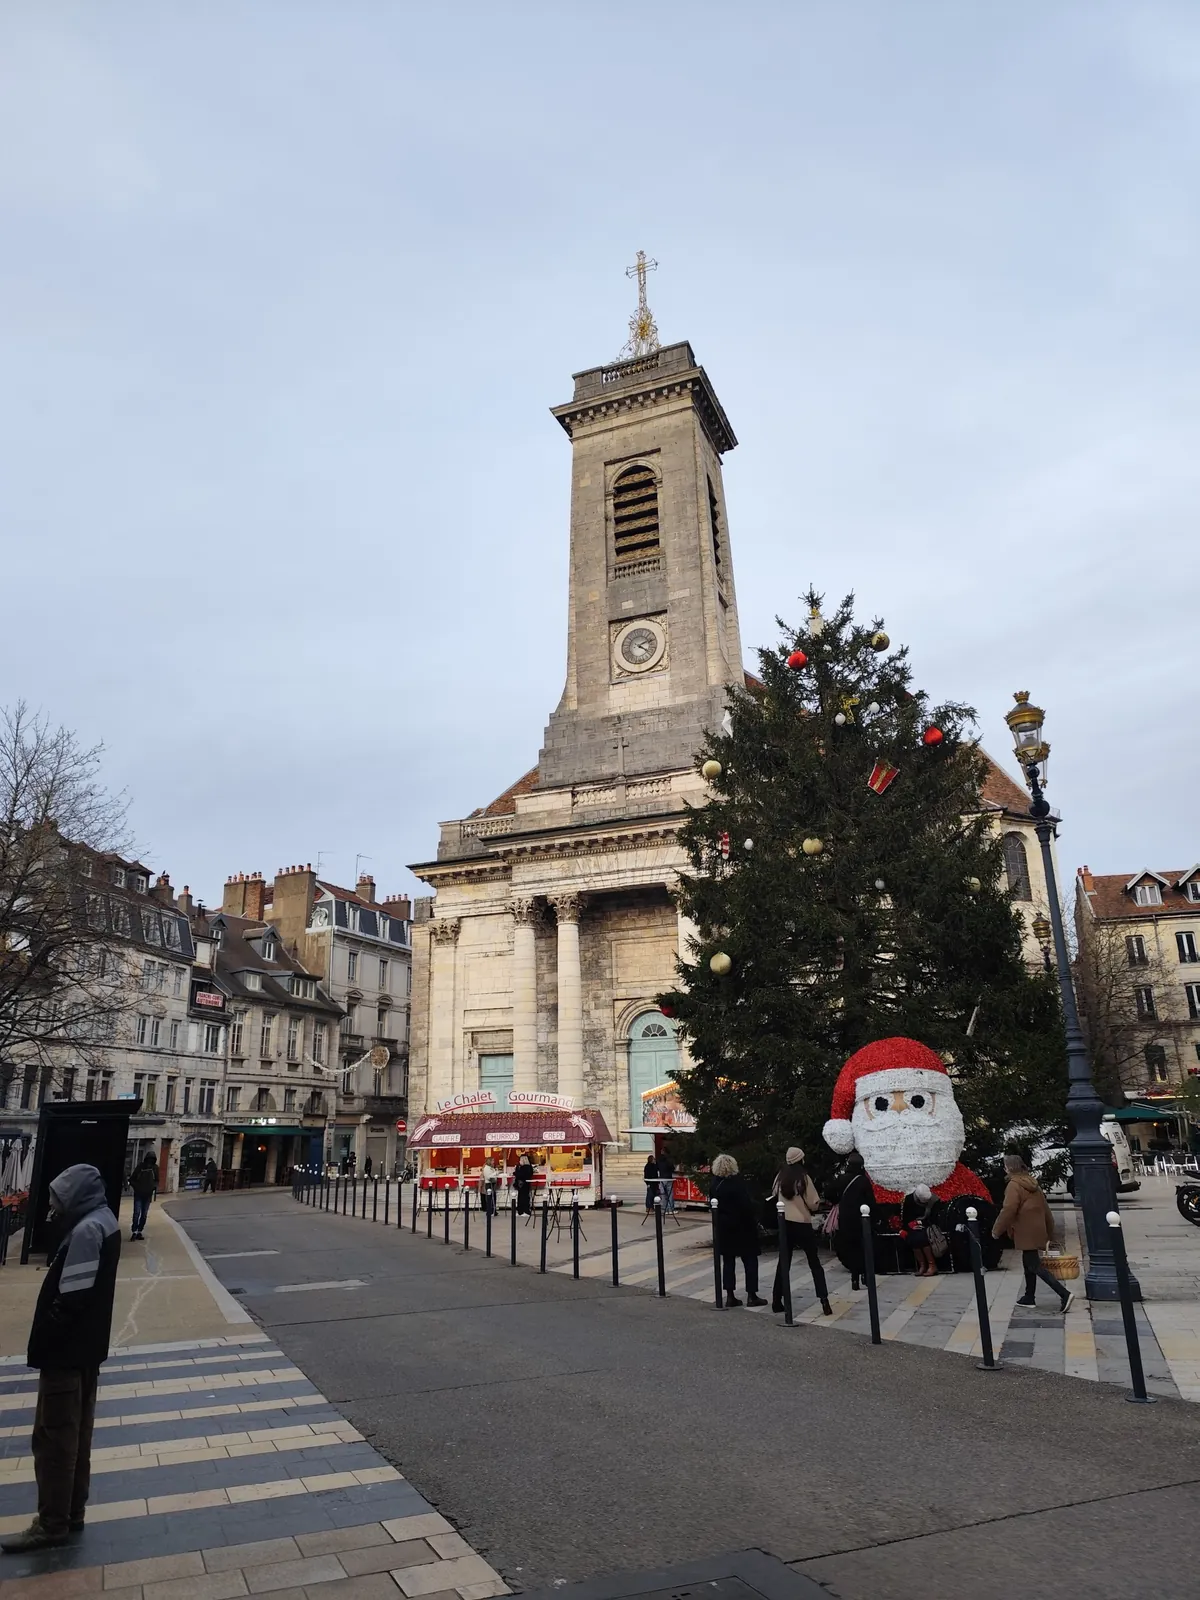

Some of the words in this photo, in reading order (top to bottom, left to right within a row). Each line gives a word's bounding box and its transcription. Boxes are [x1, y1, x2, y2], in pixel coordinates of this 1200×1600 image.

[437, 1100, 451, 1111] Le
[454, 1091, 492, 1106] Chalet
[508, 1090, 574, 1109] Gourmand
[433, 1134, 460, 1142] GAUFRE
[487, 1133, 519, 1141] CHURROS
